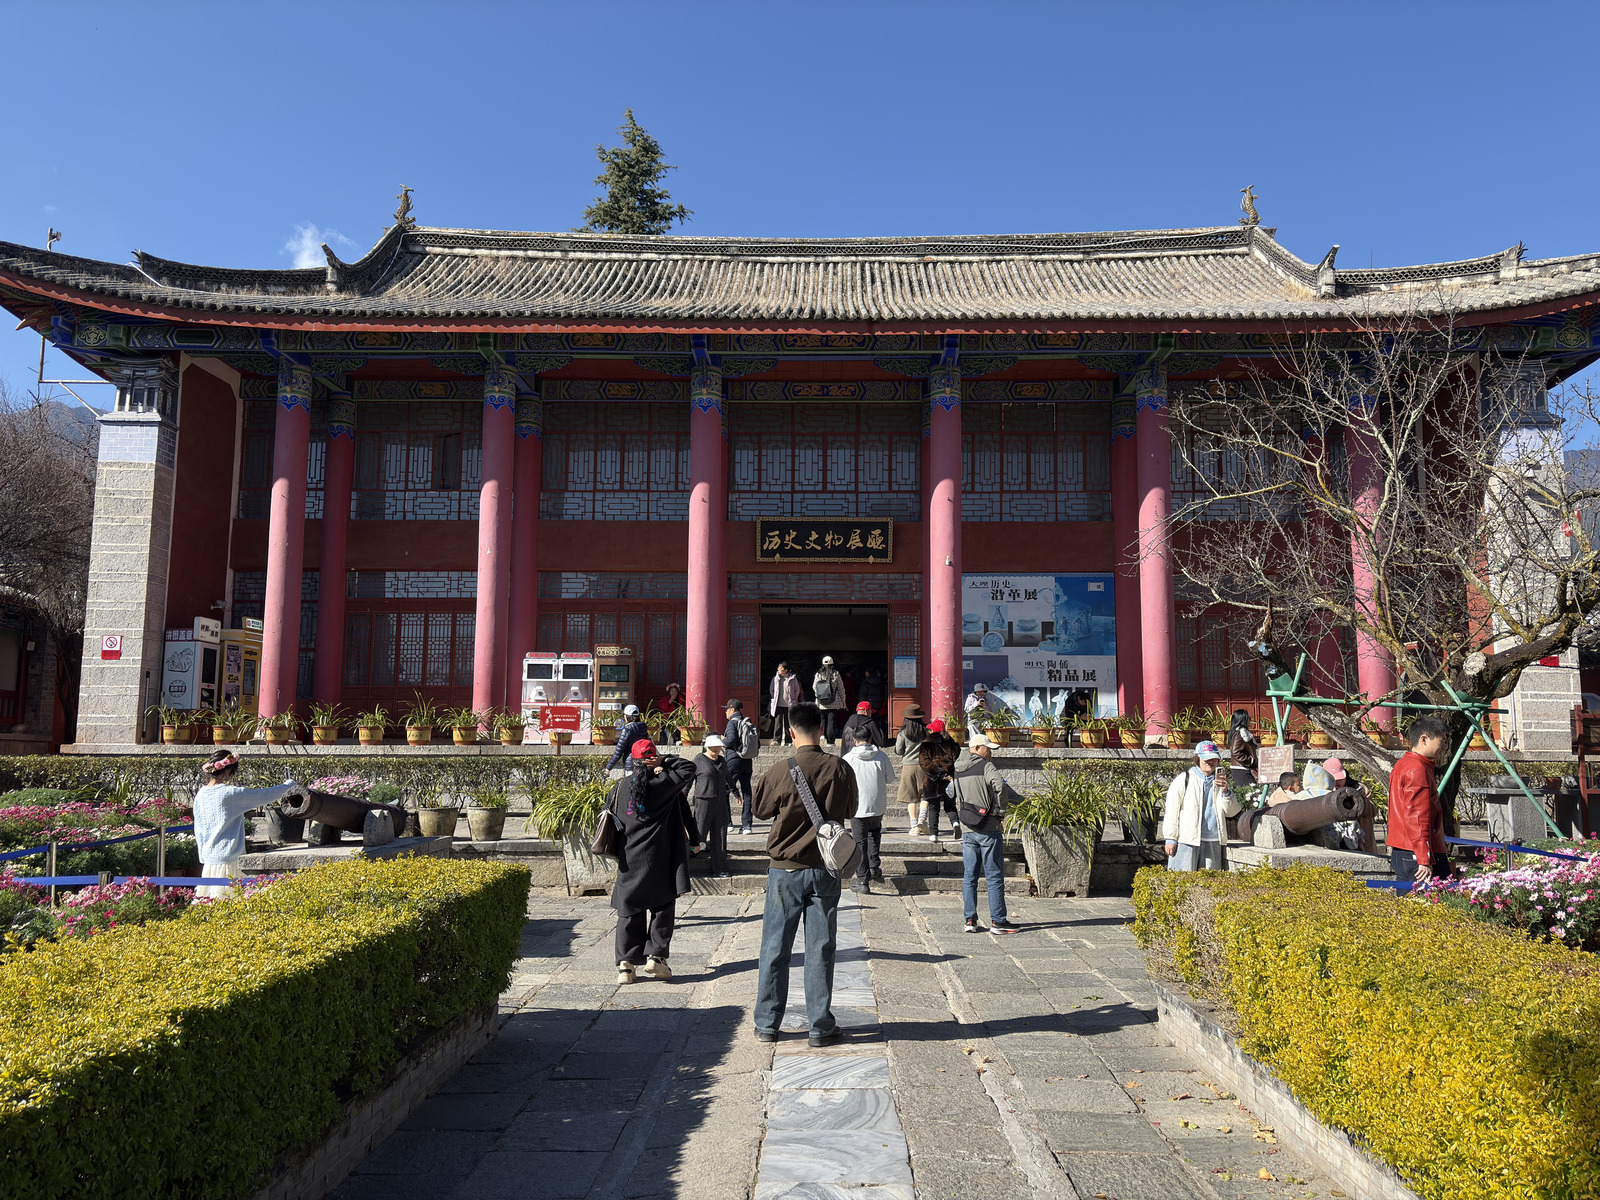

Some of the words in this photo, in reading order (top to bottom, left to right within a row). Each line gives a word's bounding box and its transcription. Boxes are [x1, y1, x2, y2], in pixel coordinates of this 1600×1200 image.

[991, 588, 1038, 601] 沿革展
[1047, 669, 1097, 682] 精品展
